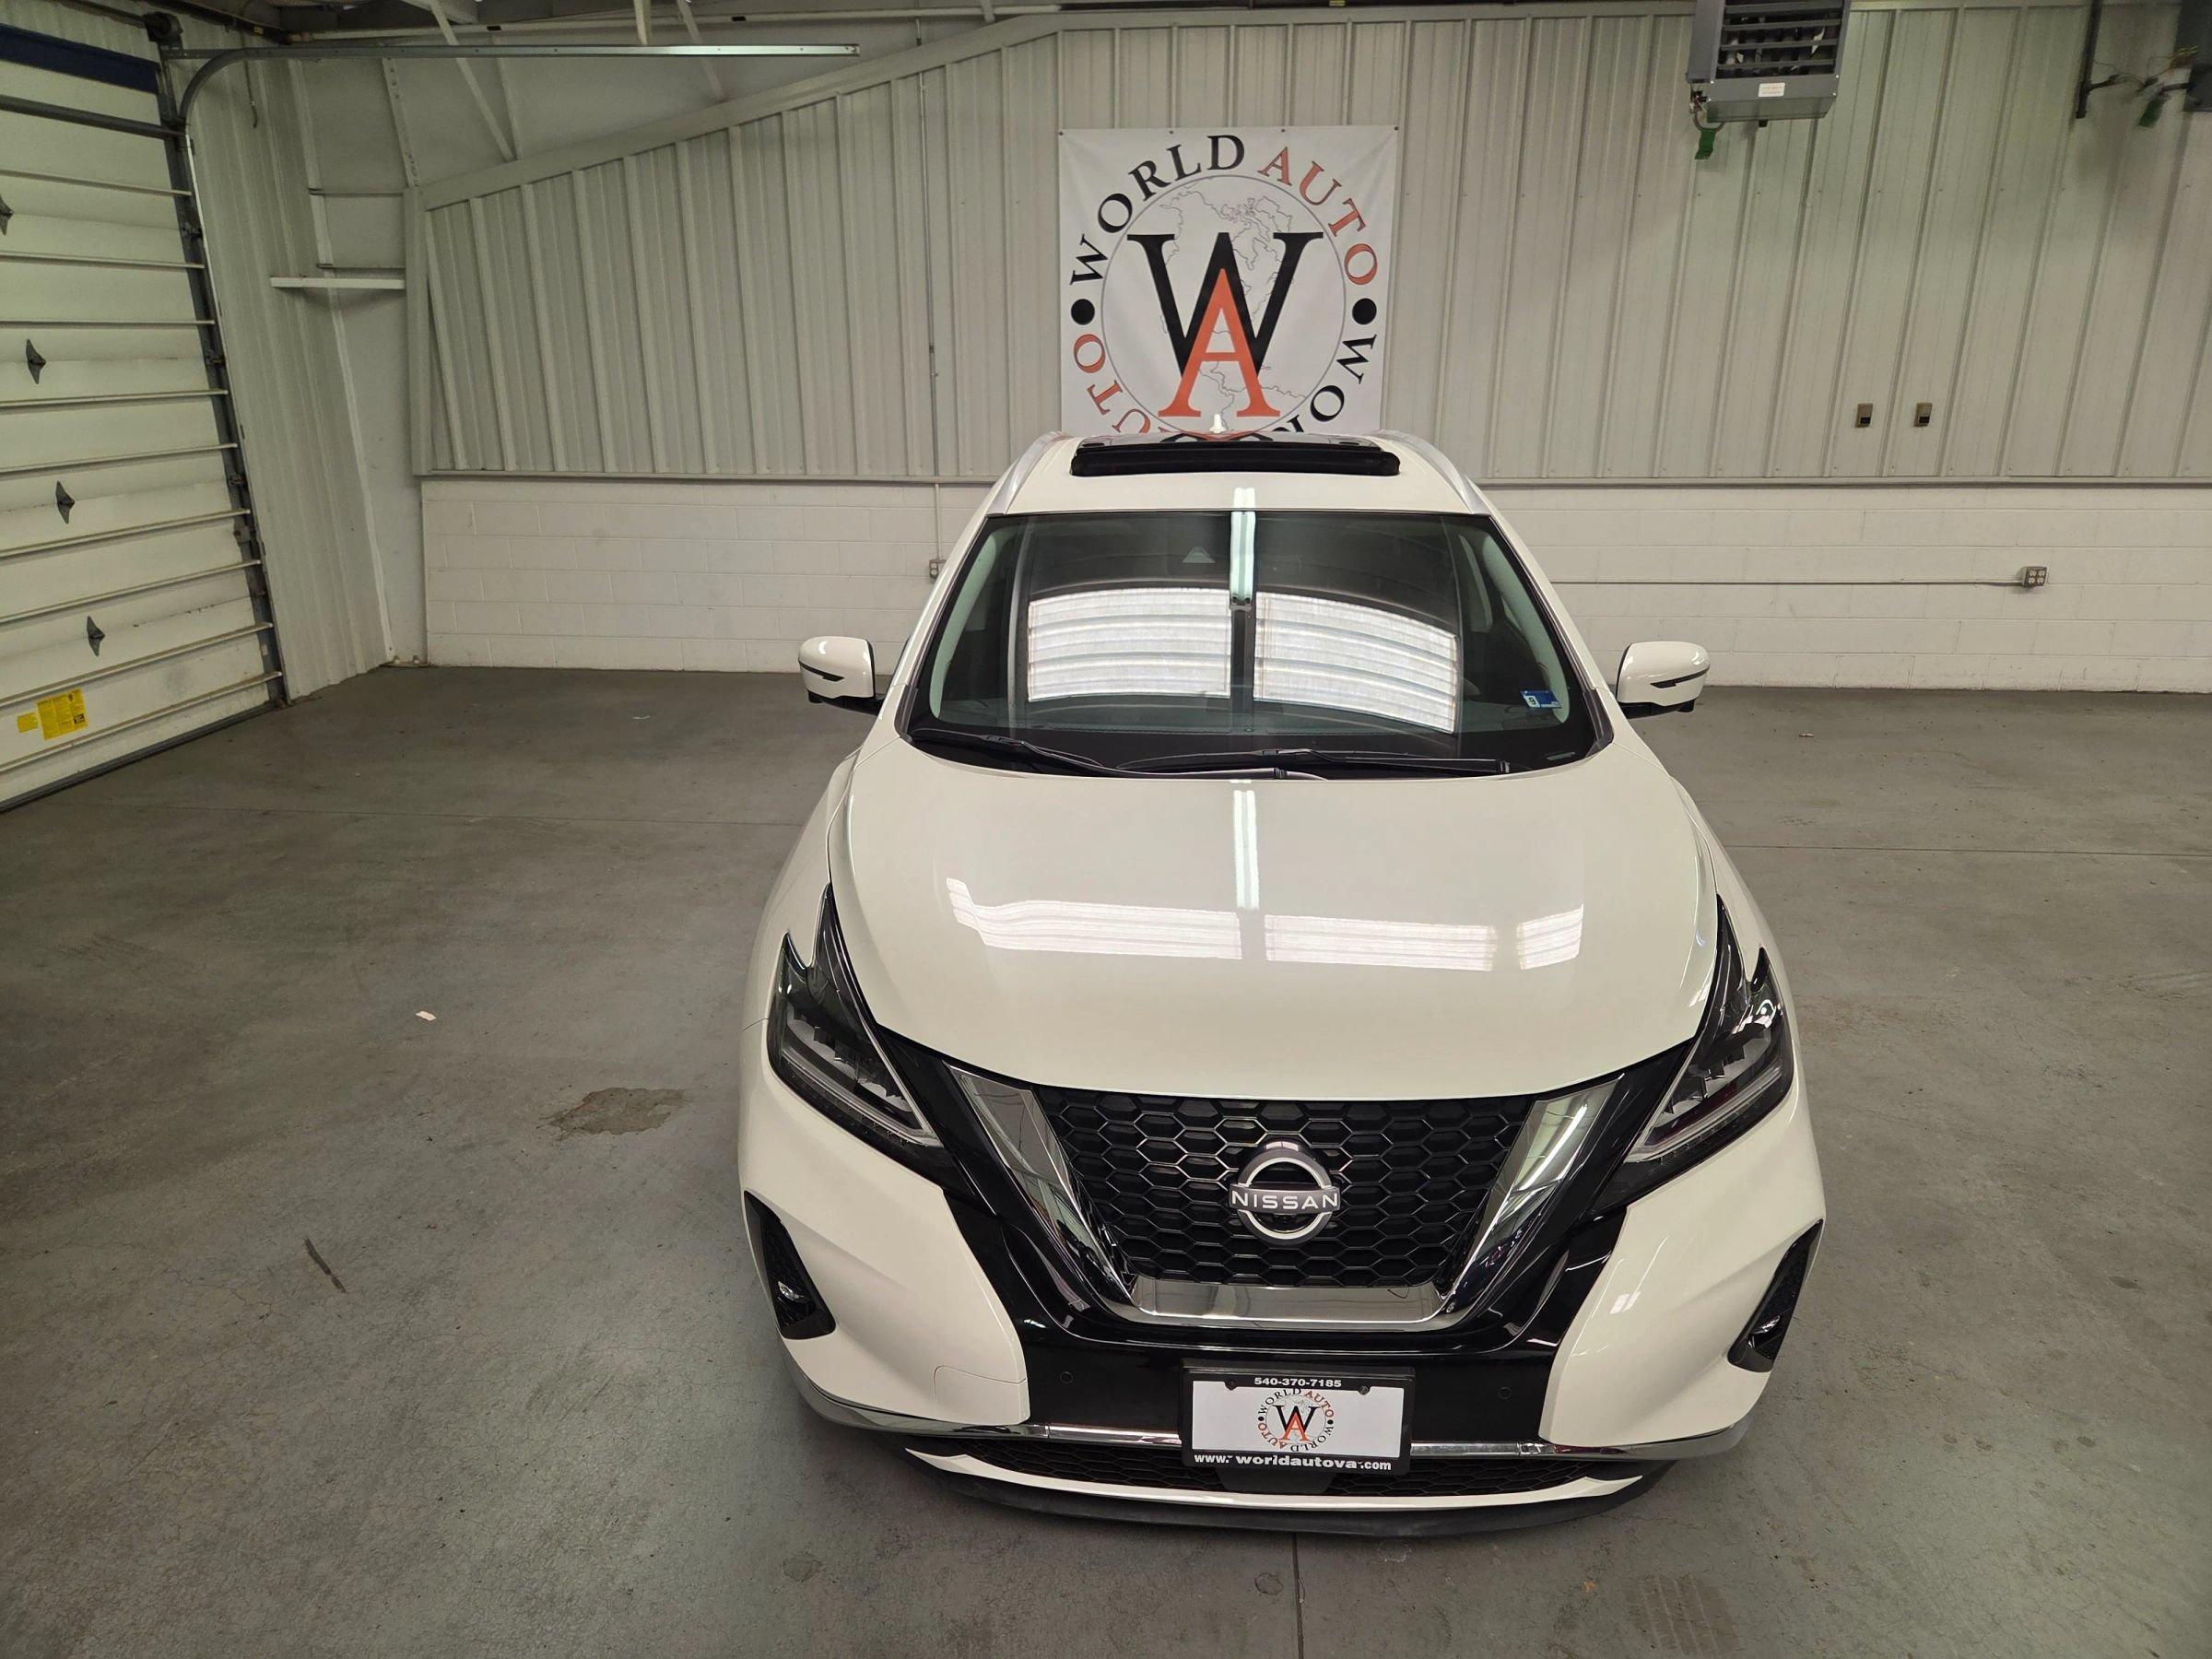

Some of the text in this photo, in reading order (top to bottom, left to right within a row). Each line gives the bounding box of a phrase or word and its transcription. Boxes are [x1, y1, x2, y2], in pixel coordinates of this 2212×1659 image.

[1069, 134, 1378, 286] WORLD AUTO
[1231, 1190, 1338, 1210] NISSAN
[1253, 1377, 1342, 1388] 540-370-7185
[1257, 1388, 1335, 1418] WORLD AUTO
[1257, 1422, 1334, 1453] WORLD AUTO
